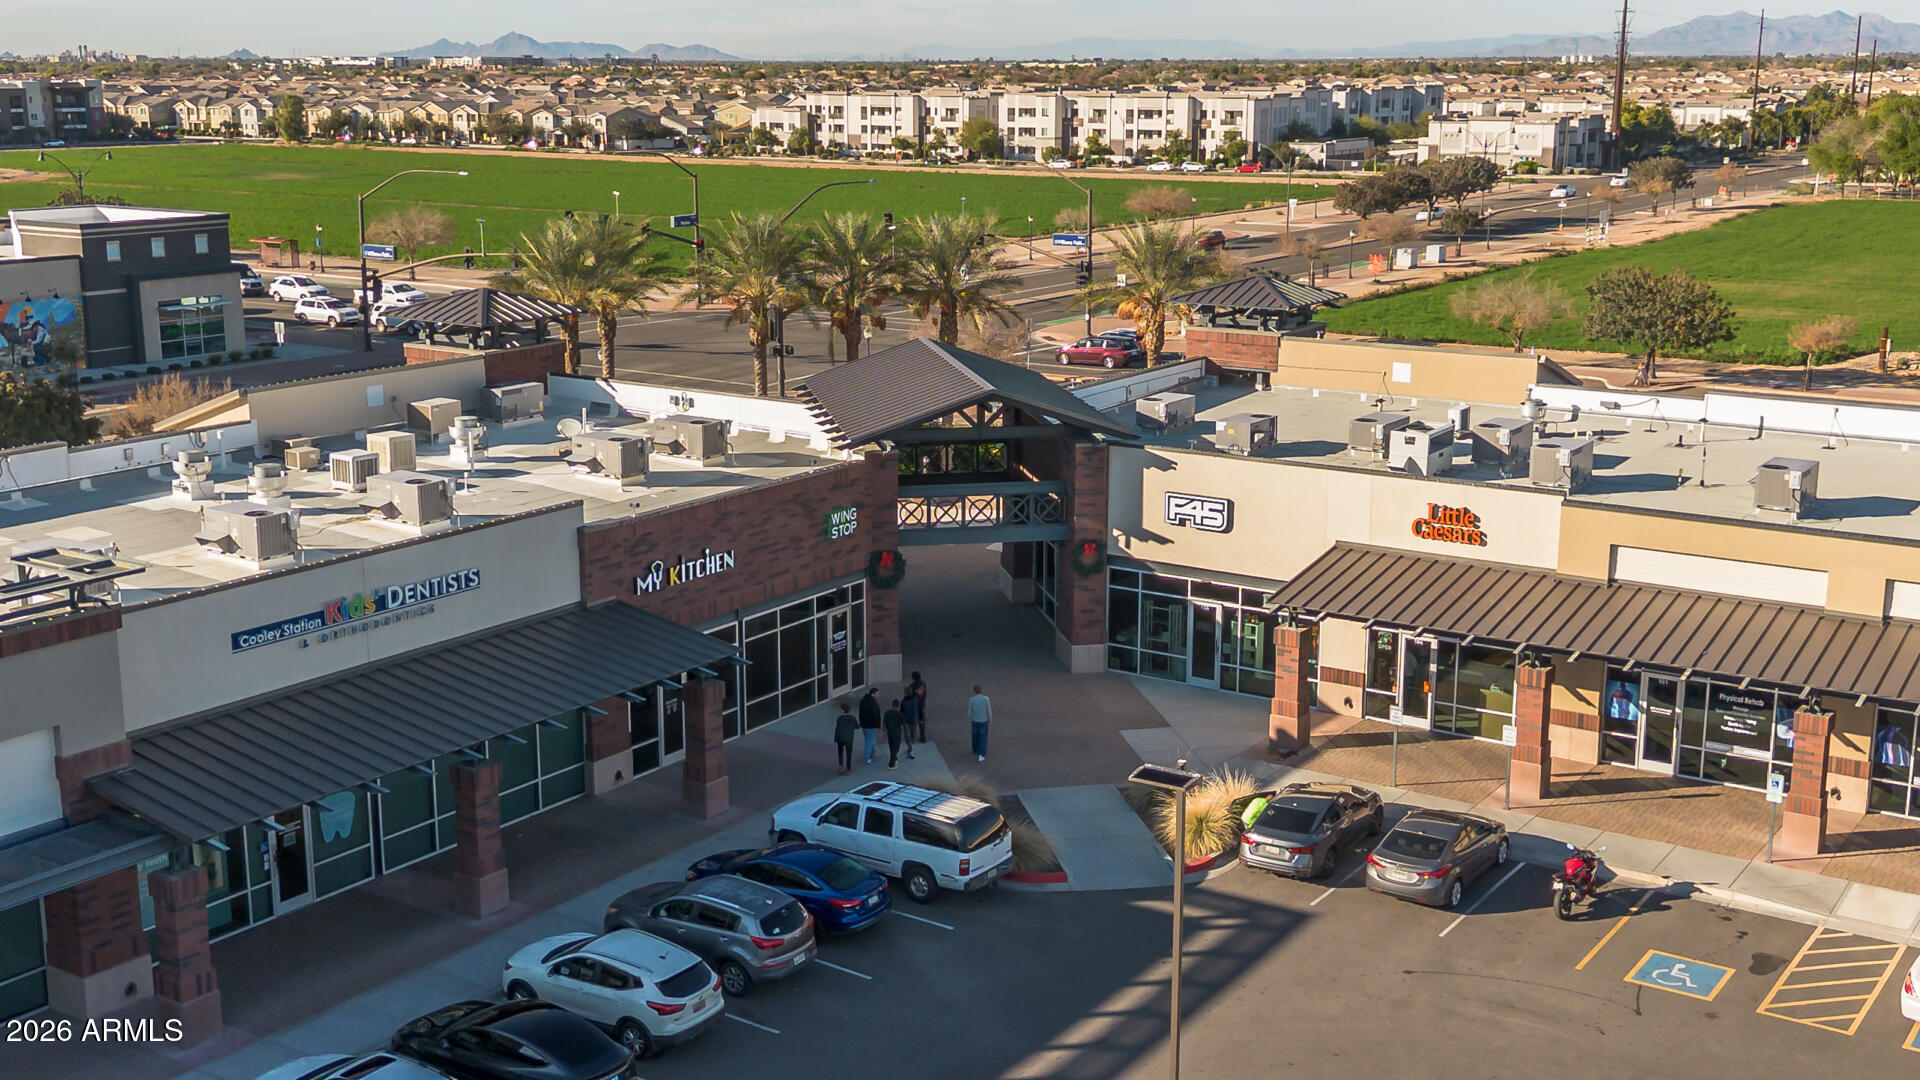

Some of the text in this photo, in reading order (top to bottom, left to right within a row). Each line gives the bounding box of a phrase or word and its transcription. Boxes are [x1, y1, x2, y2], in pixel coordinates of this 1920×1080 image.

[831, 507, 857, 525] WING
[1167, 494, 1227, 530] F45
[1427, 503, 1477, 528] Little
[831, 521, 857, 539] STOP
[1412, 518, 1484, 545] Caesars
[636, 548, 735, 596] MY KITCHEN
[239, 568, 480, 648] Cooley Station Kids' DENTISTS
[318, 605, 435, 643] ORTHODONTICS
[1720, 693, 1764, 706] Physical Rehab
